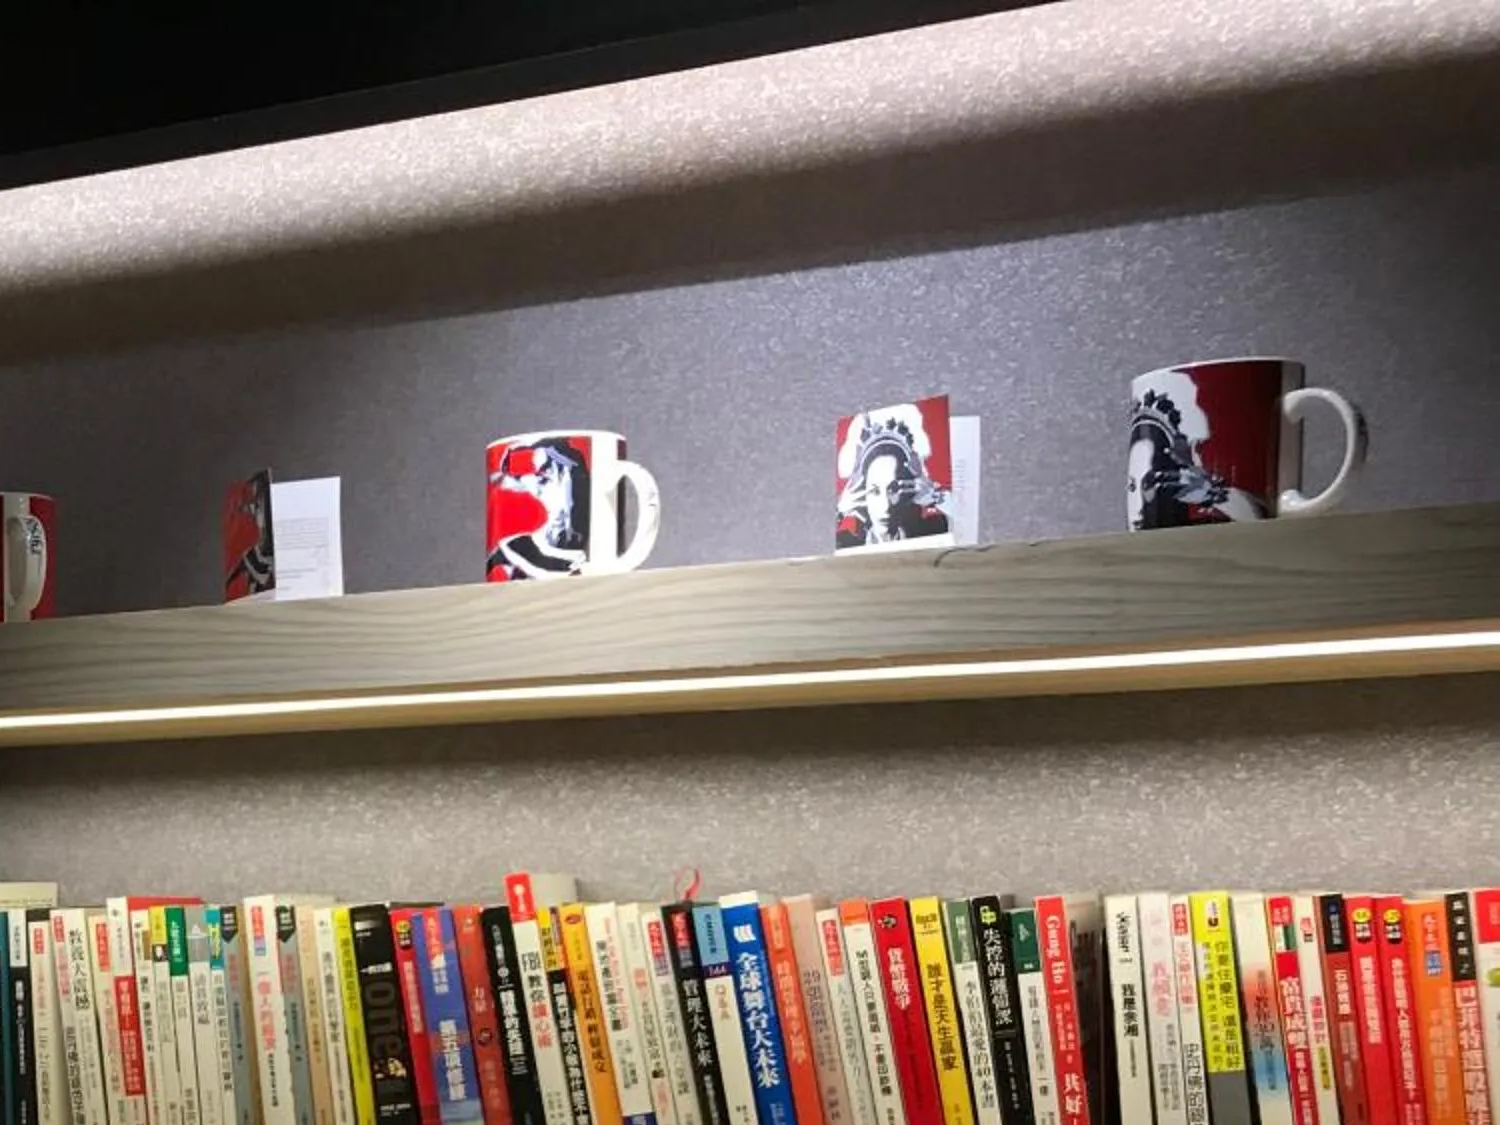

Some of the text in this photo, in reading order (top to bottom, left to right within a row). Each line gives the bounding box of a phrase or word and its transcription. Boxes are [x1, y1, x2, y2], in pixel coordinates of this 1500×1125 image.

[736, 951, 780, 1090] 全球舞台大未來
[926, 963, 958, 1072] 誰才是天生贏家
